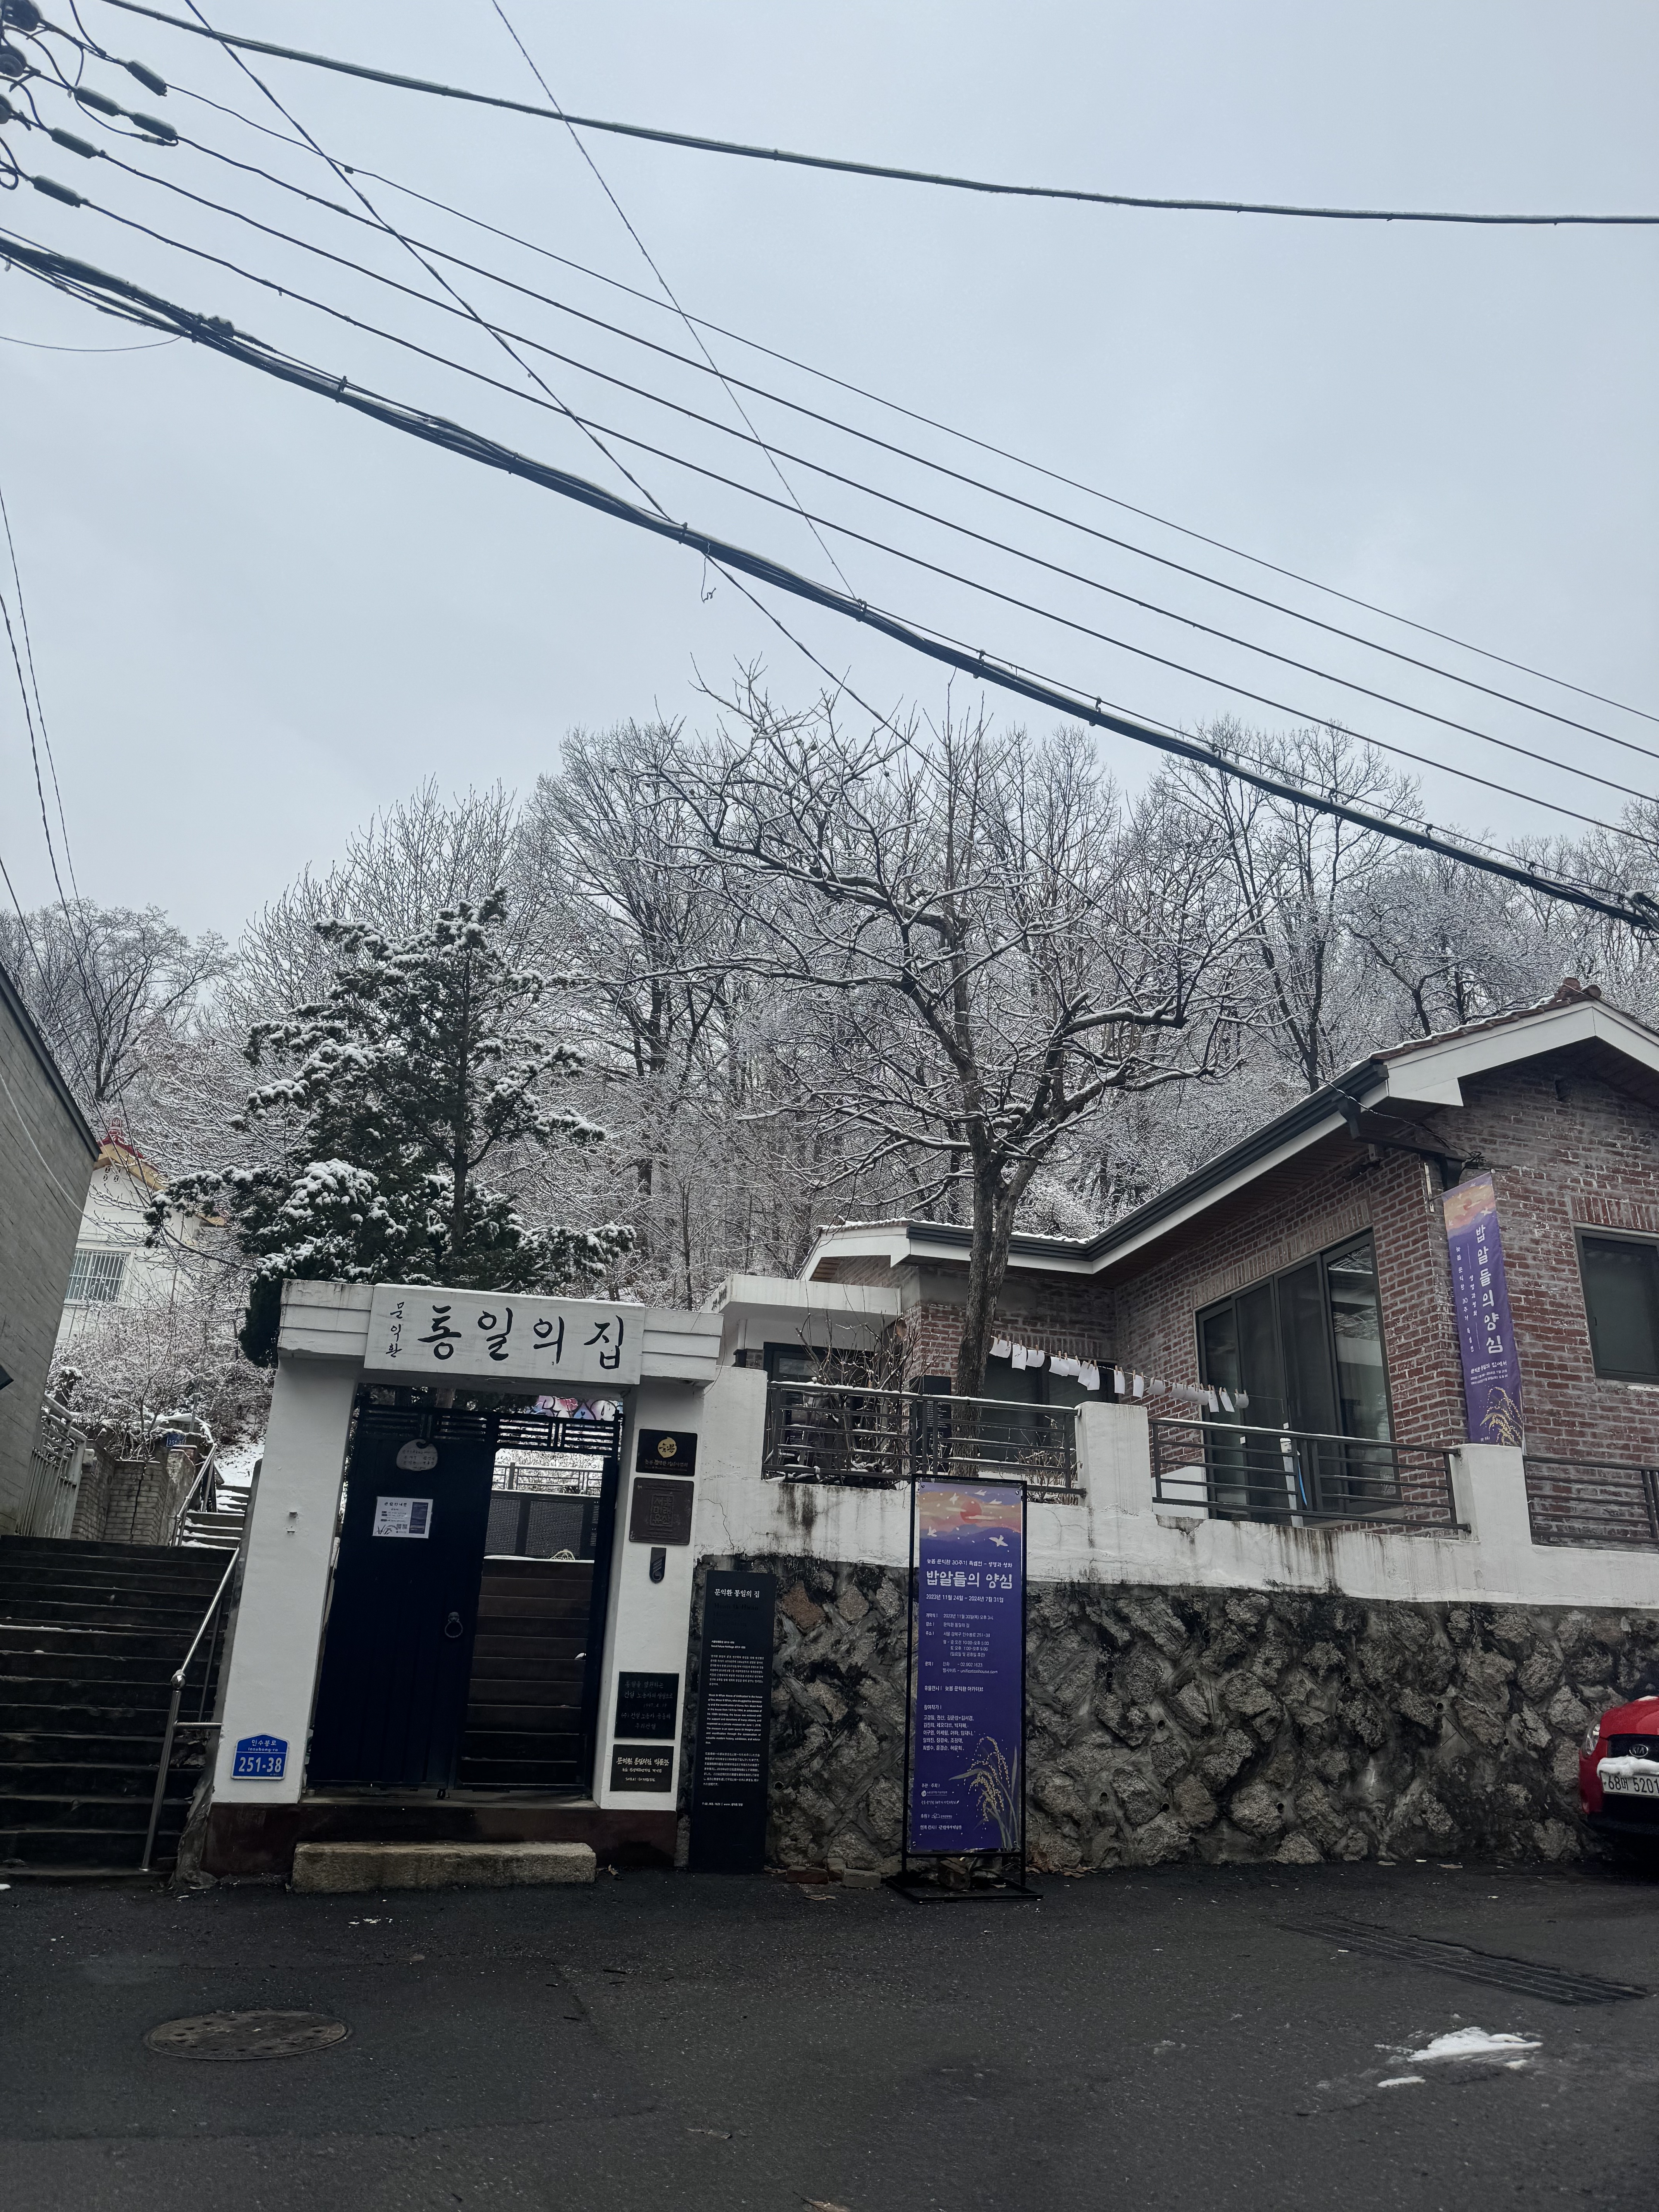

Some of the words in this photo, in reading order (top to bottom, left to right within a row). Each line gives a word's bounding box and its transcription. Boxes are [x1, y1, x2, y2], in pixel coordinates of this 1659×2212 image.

[386, 1302, 404, 1358] 문익환
[927, 1570, 979, 1587] 밥알들의
[986, 1573, 1012, 1589] 양심
[734, 1590, 752, 1598] 통일의
[239, 1757, 282, 1772] 251-38
[1633, 1778, 1659, 1794] 5201
